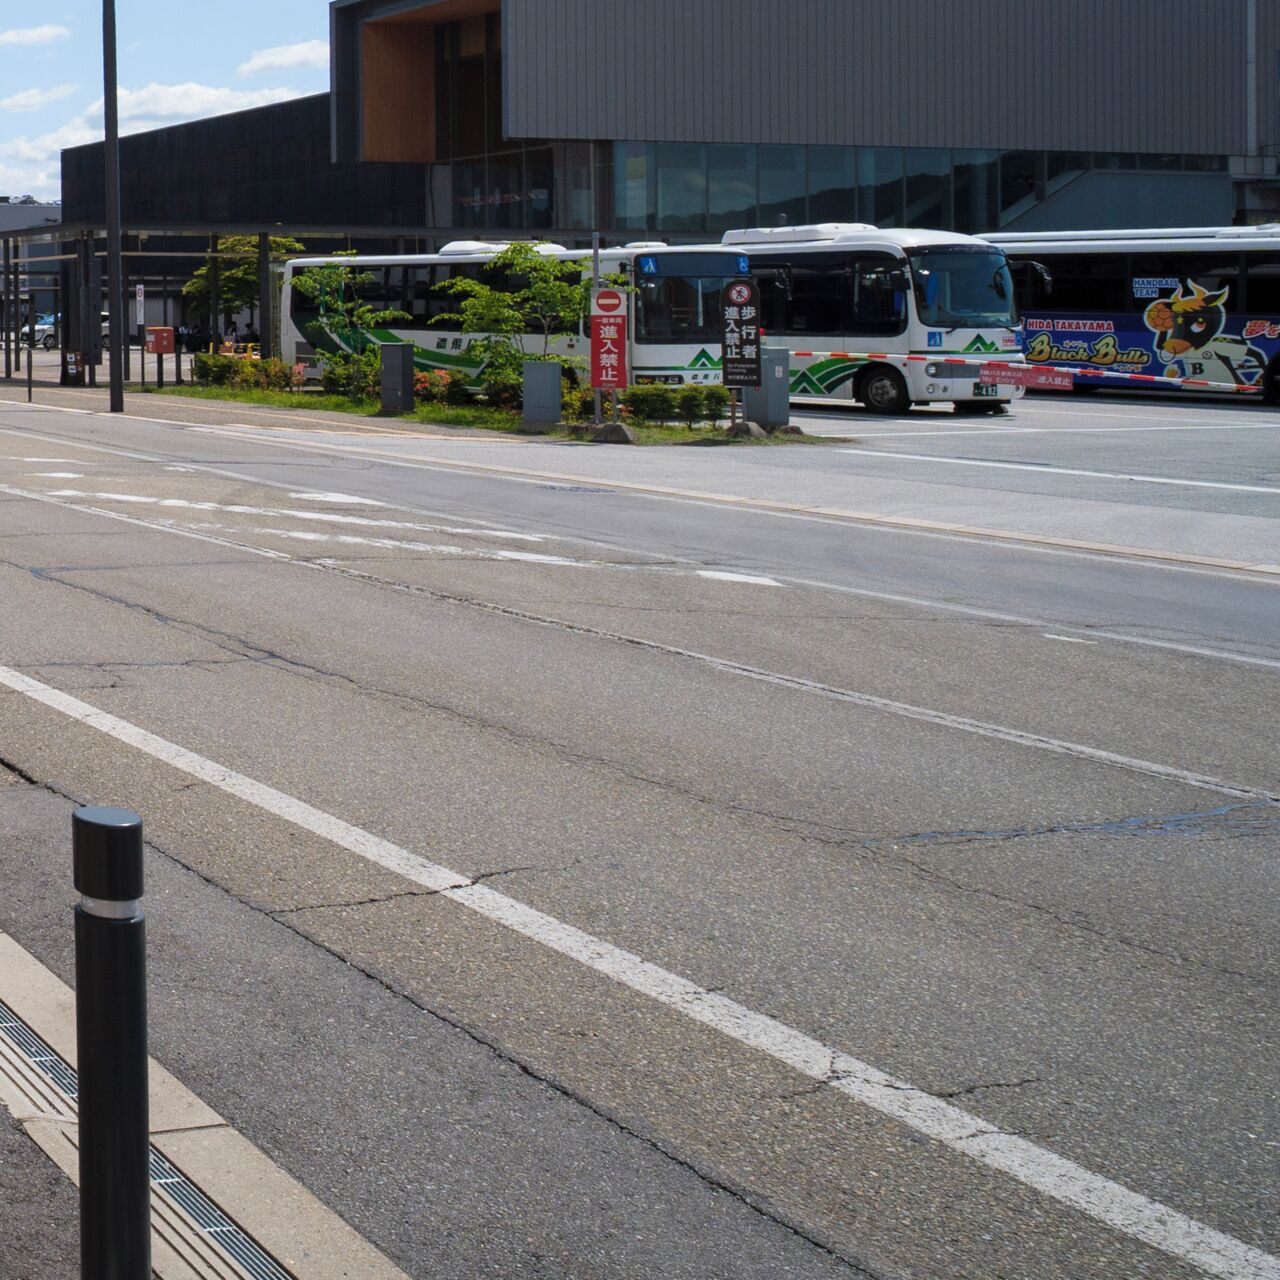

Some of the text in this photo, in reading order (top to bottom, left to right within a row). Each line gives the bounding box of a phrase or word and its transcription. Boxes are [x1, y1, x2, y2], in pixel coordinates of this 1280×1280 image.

[1133, 278, 1180, 287] HANDBALL
[1134, 288, 1158, 297] TEAM
[724, 306, 740, 359] 進入禁止
[740, 306, 758, 359] 歩行者
[1027, 319, 1115, 331] HIDA TAKAYAMA
[600, 325, 618, 381] 進入禁止
[1026, 332, 1151, 365] Black Bulls
